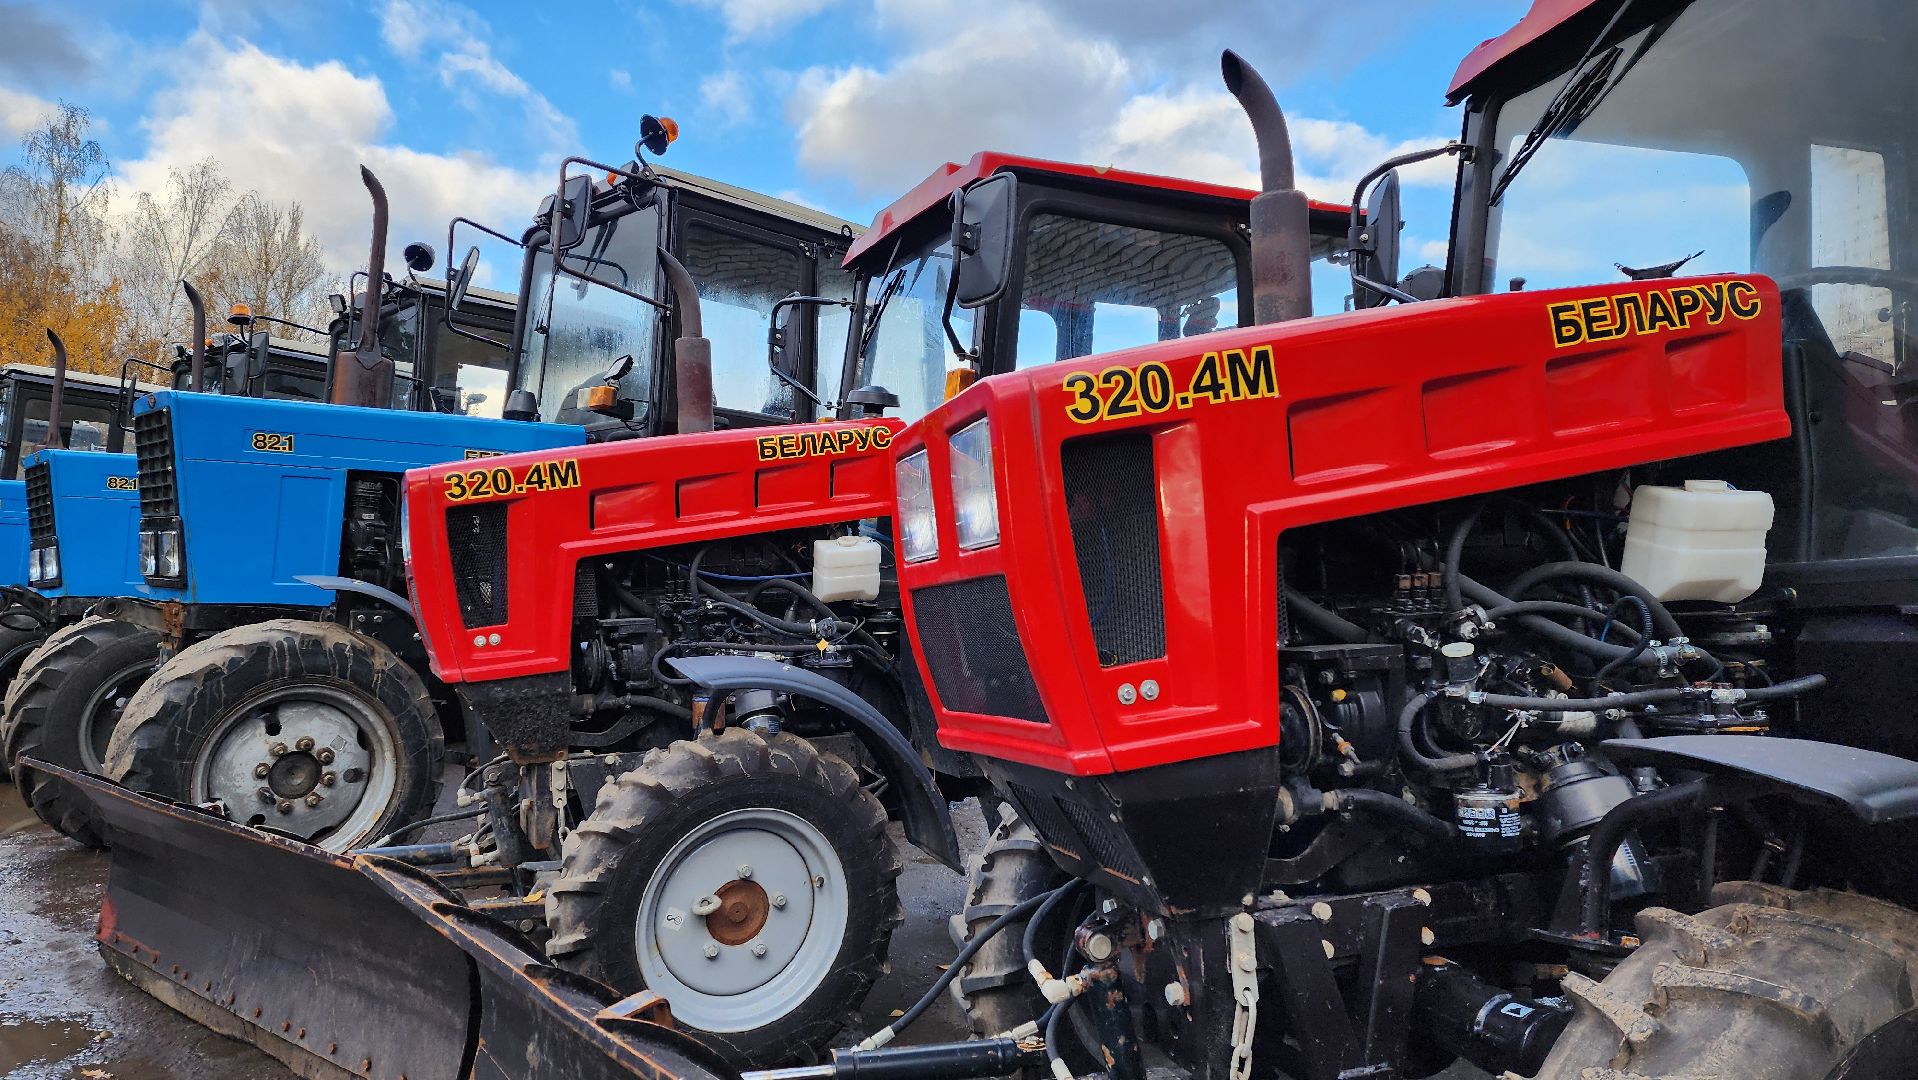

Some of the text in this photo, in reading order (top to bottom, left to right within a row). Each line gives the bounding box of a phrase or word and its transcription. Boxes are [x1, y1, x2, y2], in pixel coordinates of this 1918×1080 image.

[1548, 281, 1761, 347] БЕЛАРУС
[1063, 345, 1278, 423] 320.4М
[252, 432, 294, 452] 82.1
[756, 426, 892, 461] БЕЛАРУС
[106, 475, 138, 491] 82.1
[443, 457, 582, 502] 320.4М
